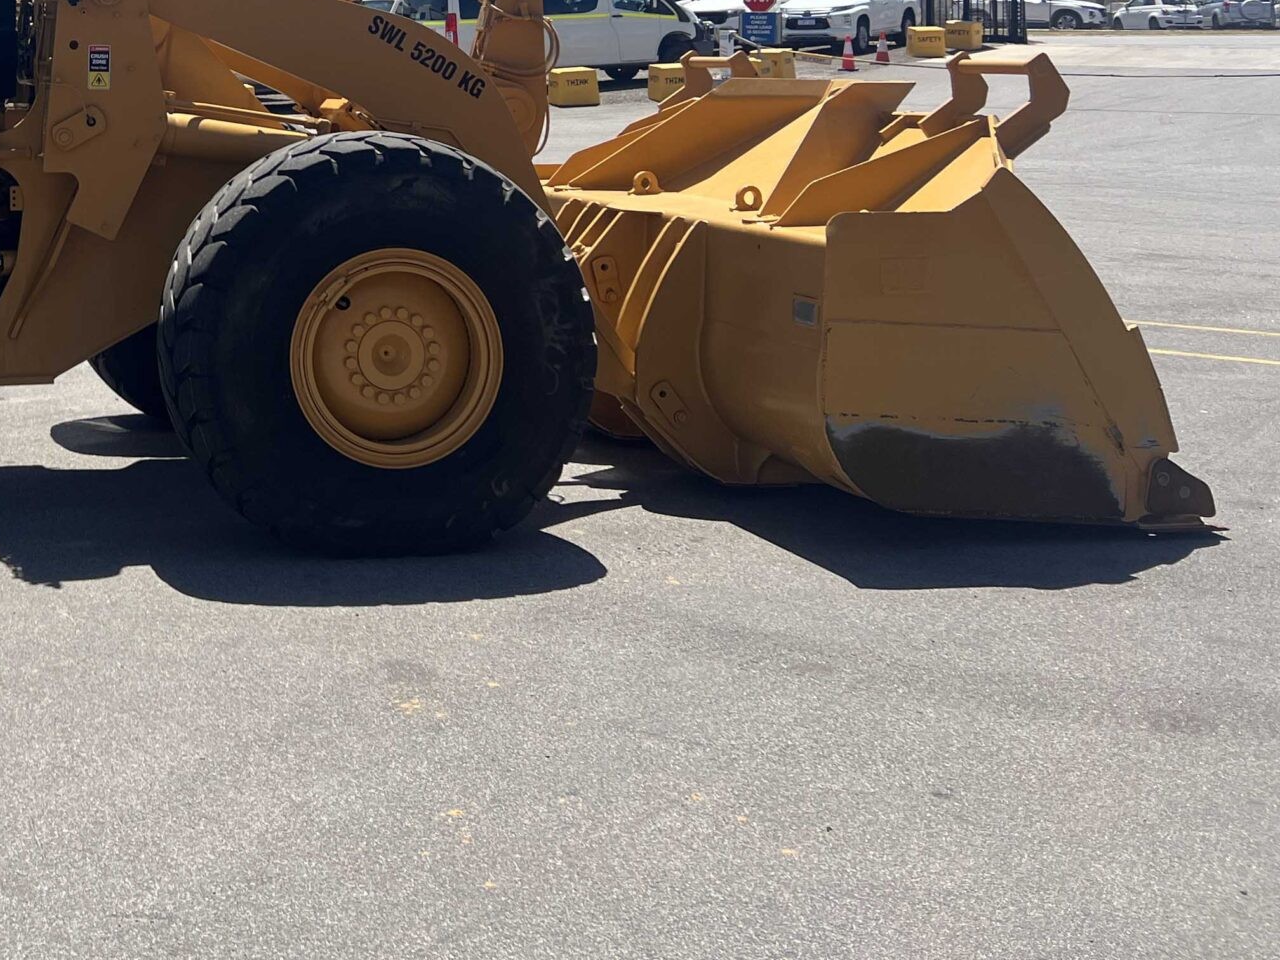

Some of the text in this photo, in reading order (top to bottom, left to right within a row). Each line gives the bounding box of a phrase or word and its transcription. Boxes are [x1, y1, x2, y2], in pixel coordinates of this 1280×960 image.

[368, 15, 486, 99] SWL 5200 KG
